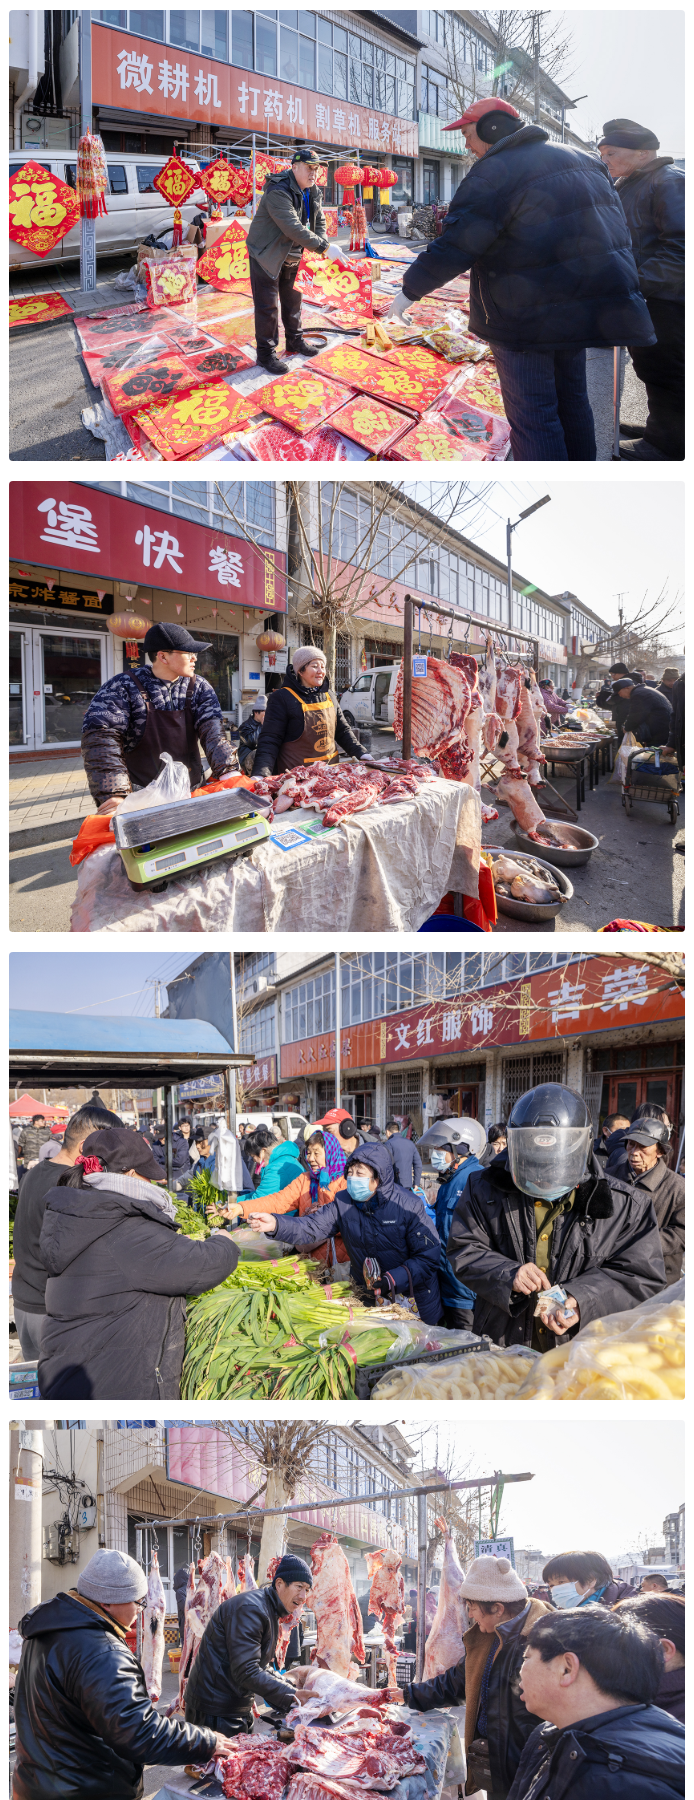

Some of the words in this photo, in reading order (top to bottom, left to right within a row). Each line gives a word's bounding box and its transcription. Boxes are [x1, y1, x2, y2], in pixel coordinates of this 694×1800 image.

[116, 49, 222, 108] 微耕机
[238, 81, 304, 125] 打药机
[315, 103, 361, 137] 割草机
[368, 117, 402, 146] 服务站
[165, 169, 186, 195] 福
[209, 170, 231, 192] 福
[9, 182, 67, 228] 福
[215, 242, 250, 280] 福
[376, 370, 424, 394] 福
[174, 388, 231, 426] 福
[38, 498, 245, 588] 堡快餐
[548, 965, 685, 1021] 吉荣
[394, 1001, 493, 1051] 文红服饰
[480, 1543, 508, 1554] 清真
